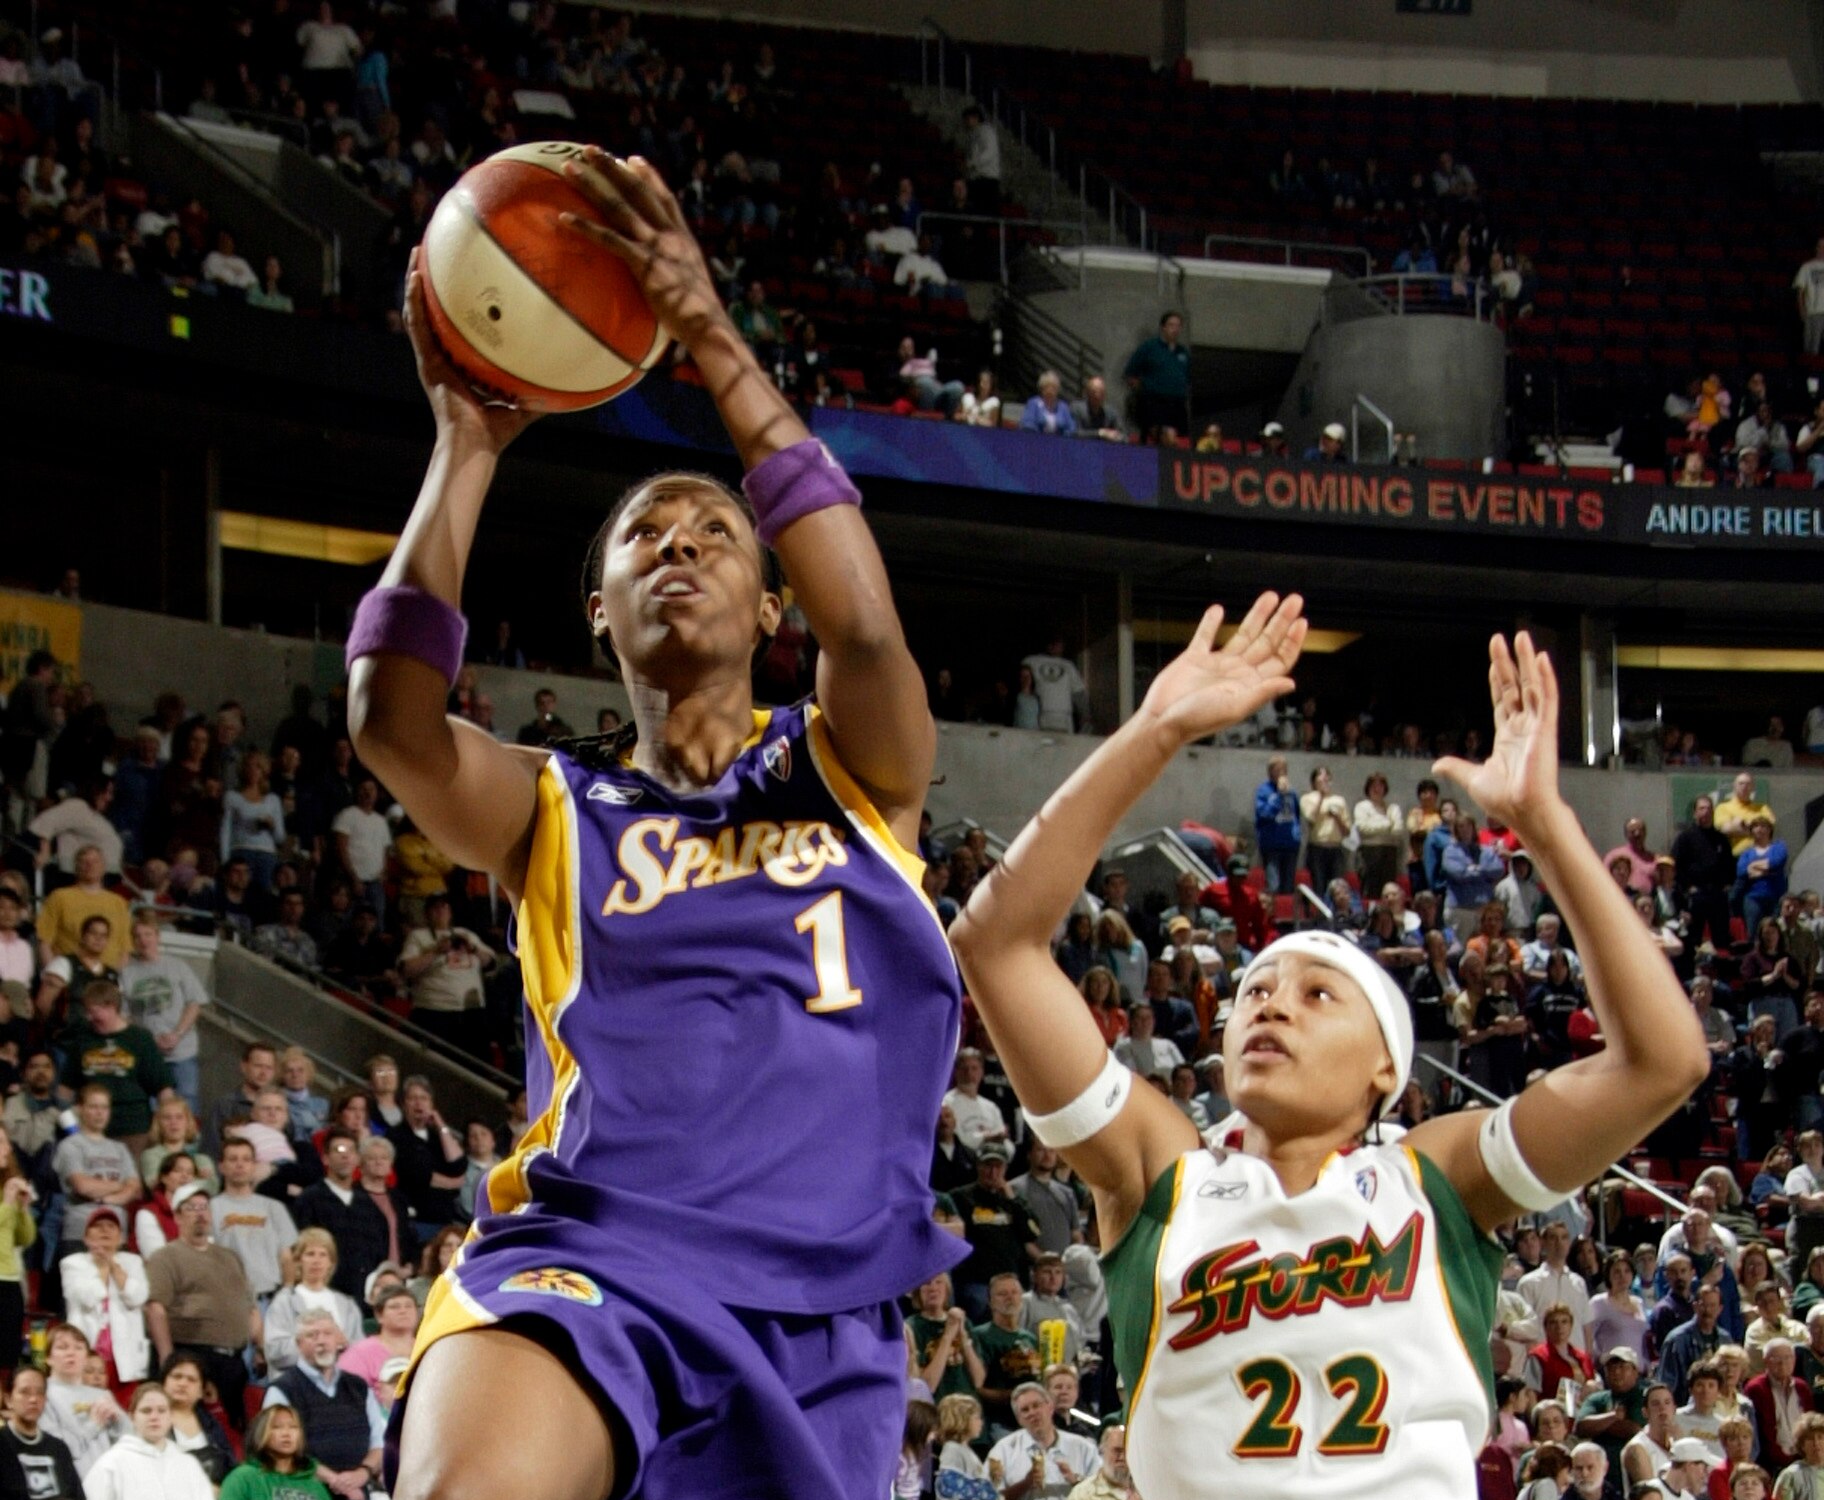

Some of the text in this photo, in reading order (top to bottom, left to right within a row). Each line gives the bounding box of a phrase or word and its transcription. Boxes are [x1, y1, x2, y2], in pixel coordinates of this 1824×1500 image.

[1173, 460, 1605, 530] UPCOMING EVENTS
[1645, 503, 1751, 535] ANDRE
[794, 889, 863, 1014] 1
[1166, 1209, 1425, 1352] STORM
[1229, 1352, 1392, 1461] 22
